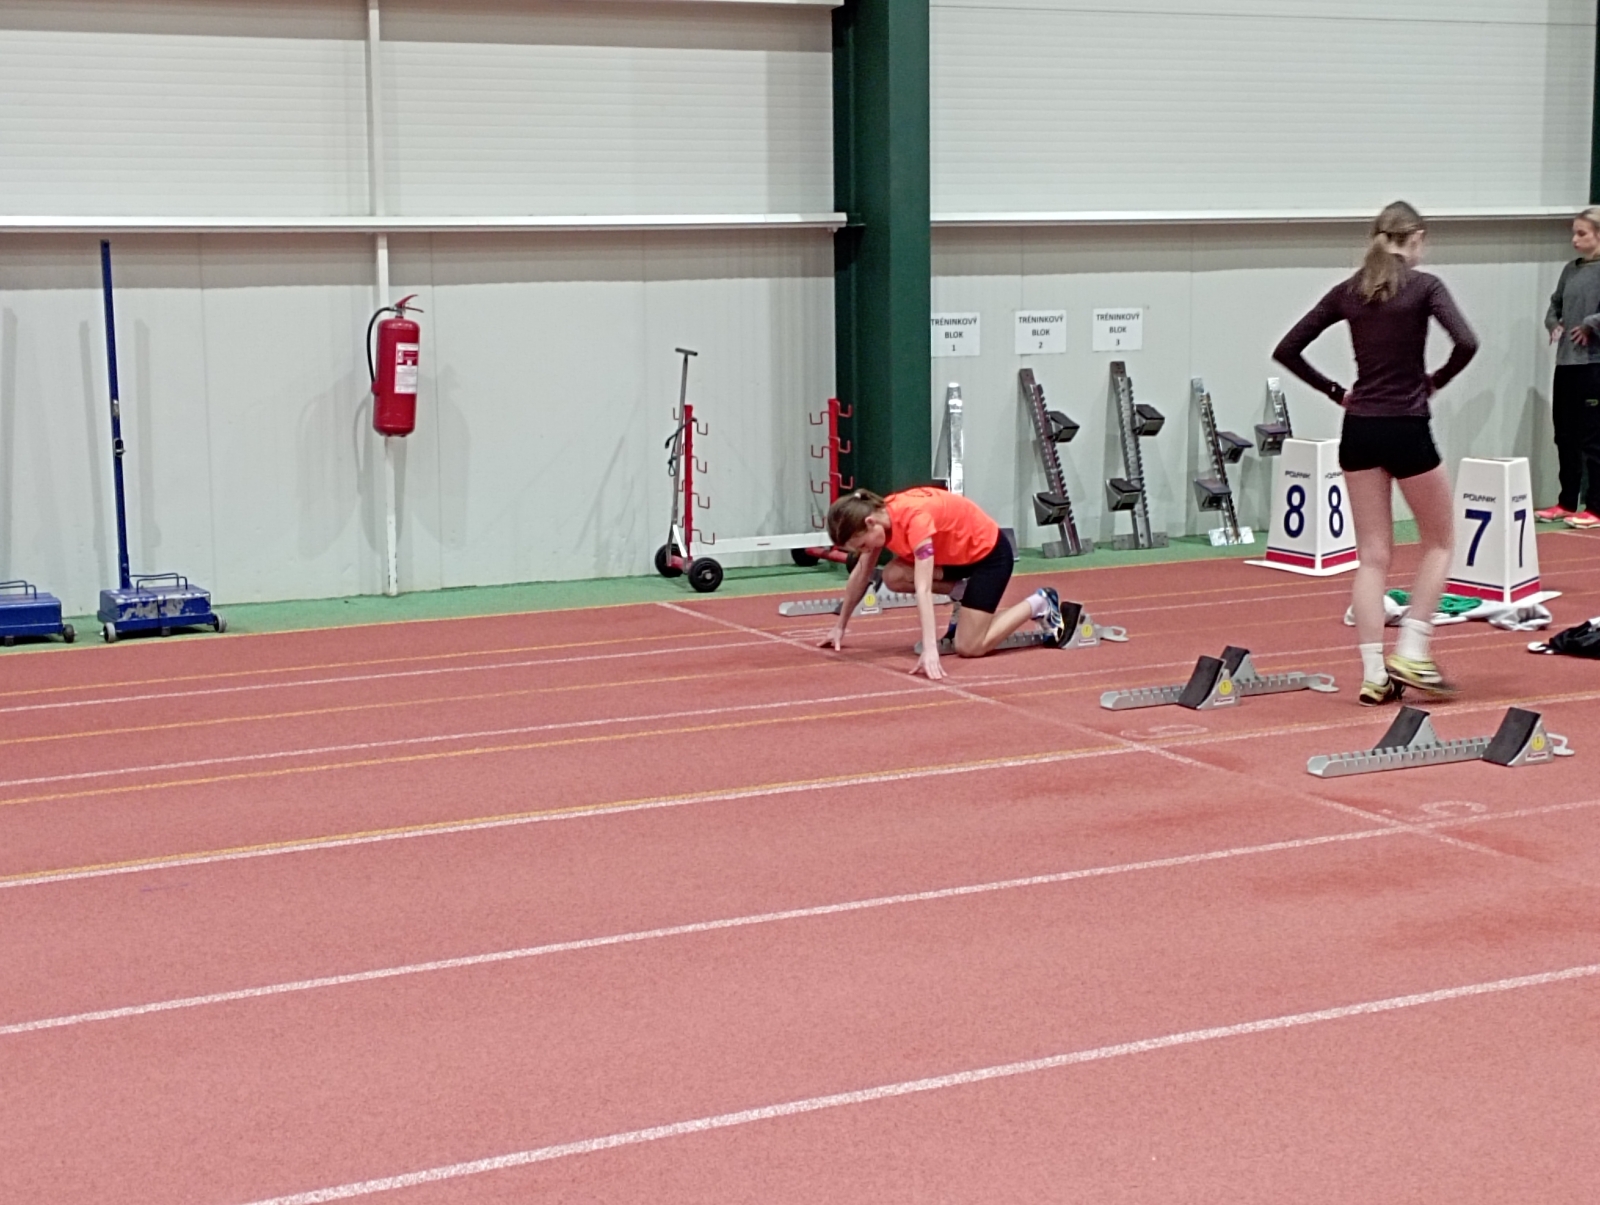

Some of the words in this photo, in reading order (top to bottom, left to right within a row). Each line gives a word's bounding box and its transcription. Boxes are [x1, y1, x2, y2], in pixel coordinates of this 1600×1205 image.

[1018, 315, 1064, 324] TRÉNINKOVÝ
[1096, 313, 1140, 322] TRÉNINKOVÝ
[944, 331, 964, 339] BLOK
[1115, 338, 1120, 346] 3
[1463, 493, 1497, 503] POLANIK
[1283, 484, 1306, 538] 8
[1327, 484, 1344, 538] 8
[1464, 508, 1492, 567] 7
[1513, 508, 1526, 568] 7
